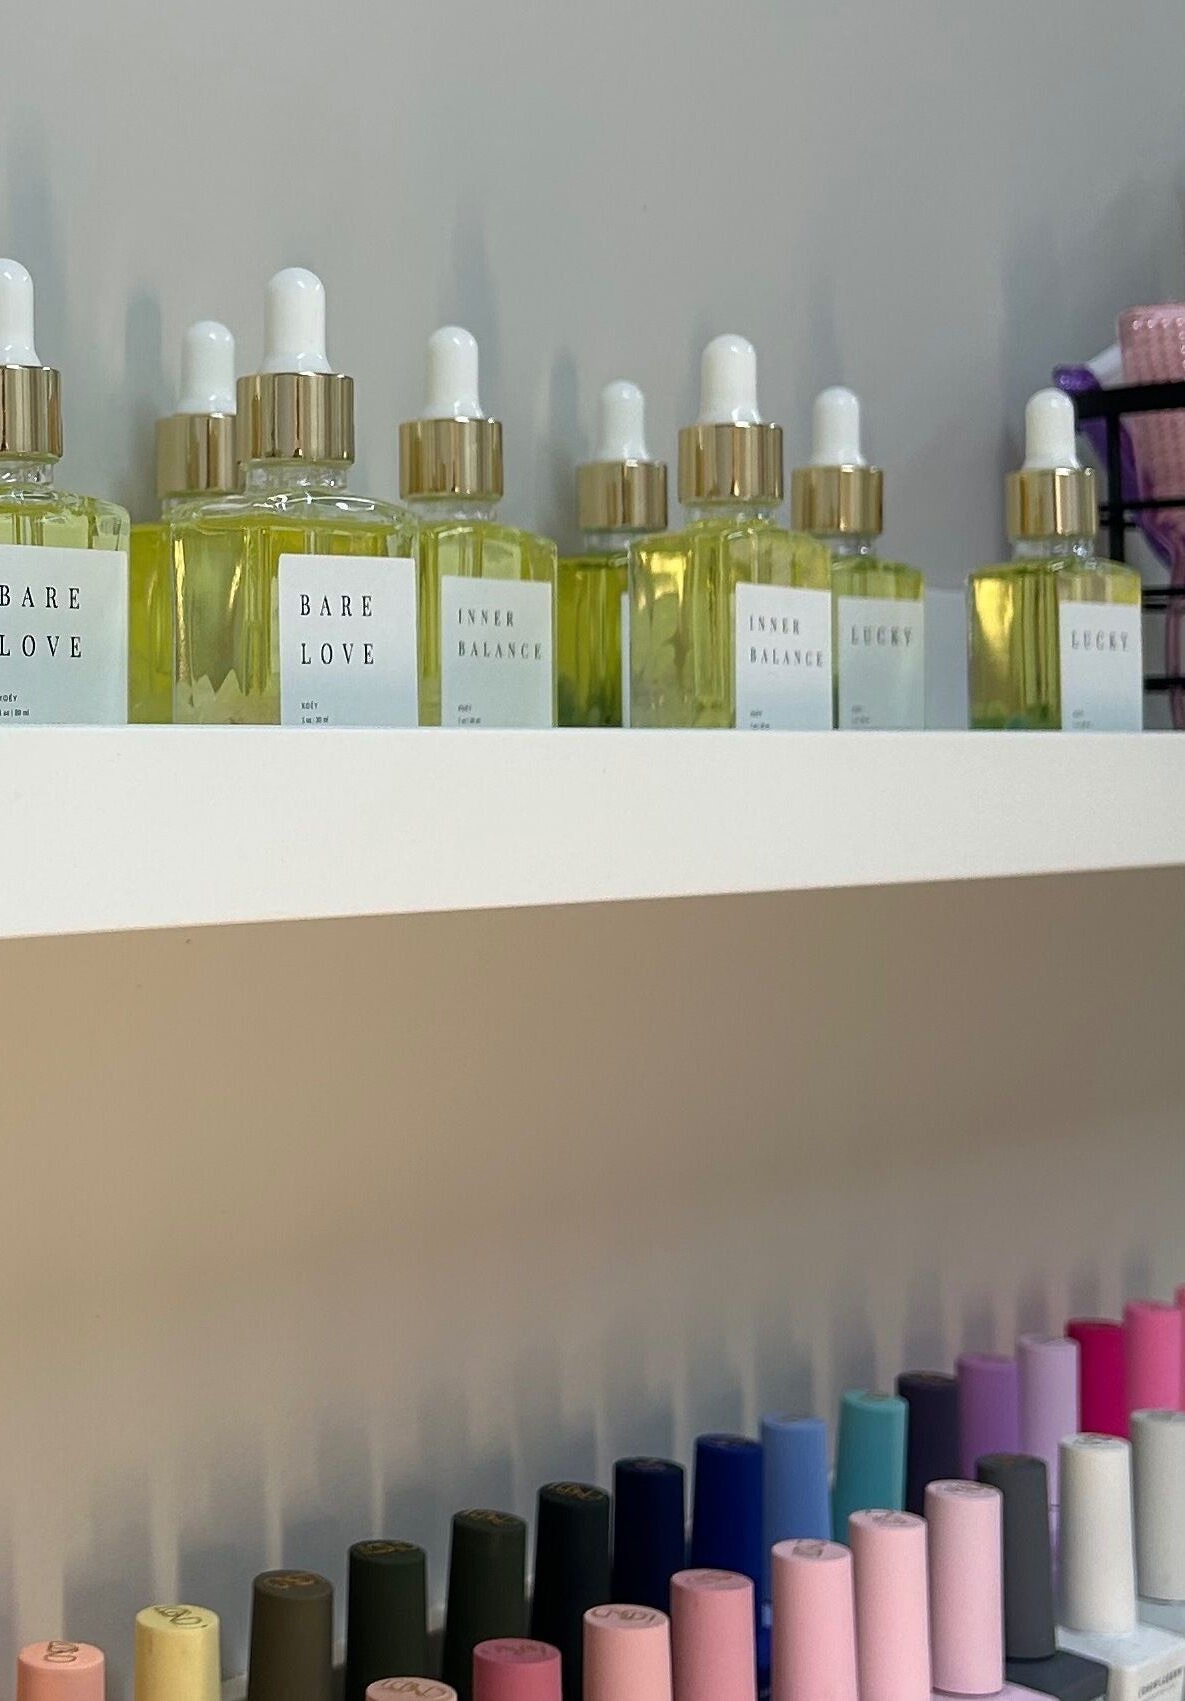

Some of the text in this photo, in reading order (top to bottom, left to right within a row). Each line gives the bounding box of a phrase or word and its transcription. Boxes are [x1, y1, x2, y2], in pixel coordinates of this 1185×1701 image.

[300, 594, 373, 617] BARE
[457, 608, 515, 627] INNER
[749, 615, 800, 636] INNER
[851, 624, 912, 647] LUCKY
[1071, 628, 1129, 652] LUCKY
[301, 642, 374, 665] LOVE
[458, 640, 543, 660] BALANCE
[750, 647, 824, 668] BALANCE
